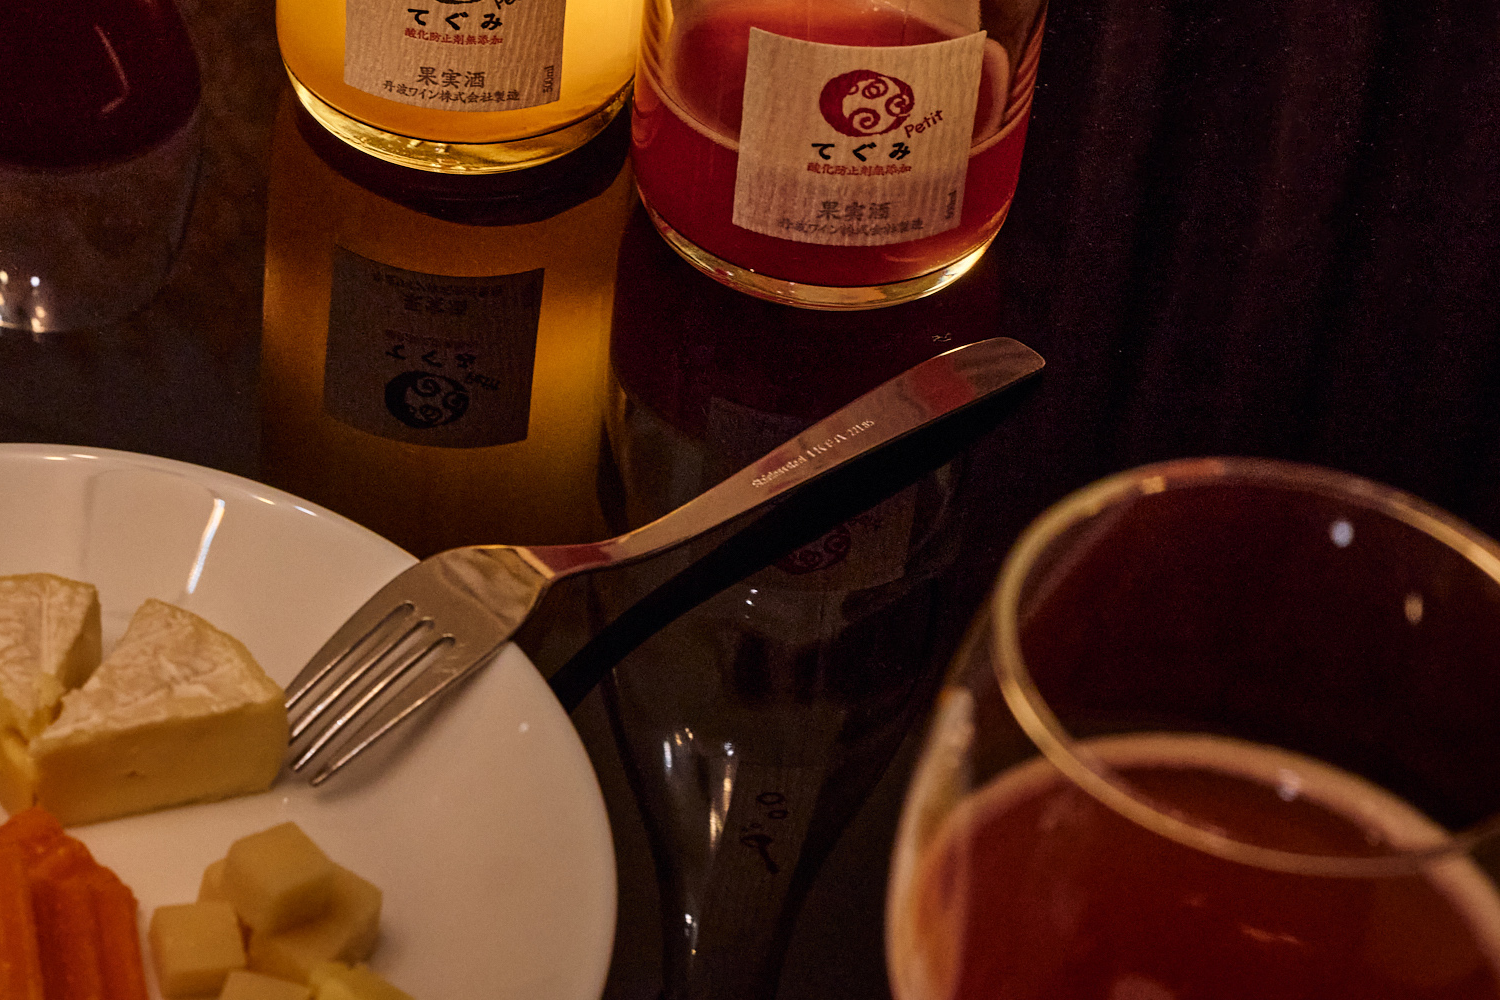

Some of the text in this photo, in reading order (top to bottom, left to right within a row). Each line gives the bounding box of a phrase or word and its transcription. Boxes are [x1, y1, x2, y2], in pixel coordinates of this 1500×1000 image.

[407, 8, 503, 31] てぐみ
[404, 28, 503, 45] 酸化防止剤無添加
[416, 66, 486, 90] 果実酒
[903, 109, 944, 138] Petit
[811, 141, 911, 162] てぐみ
[815, 200, 891, 222] 果実酒
[806, 433, 847, 458] IKEA
